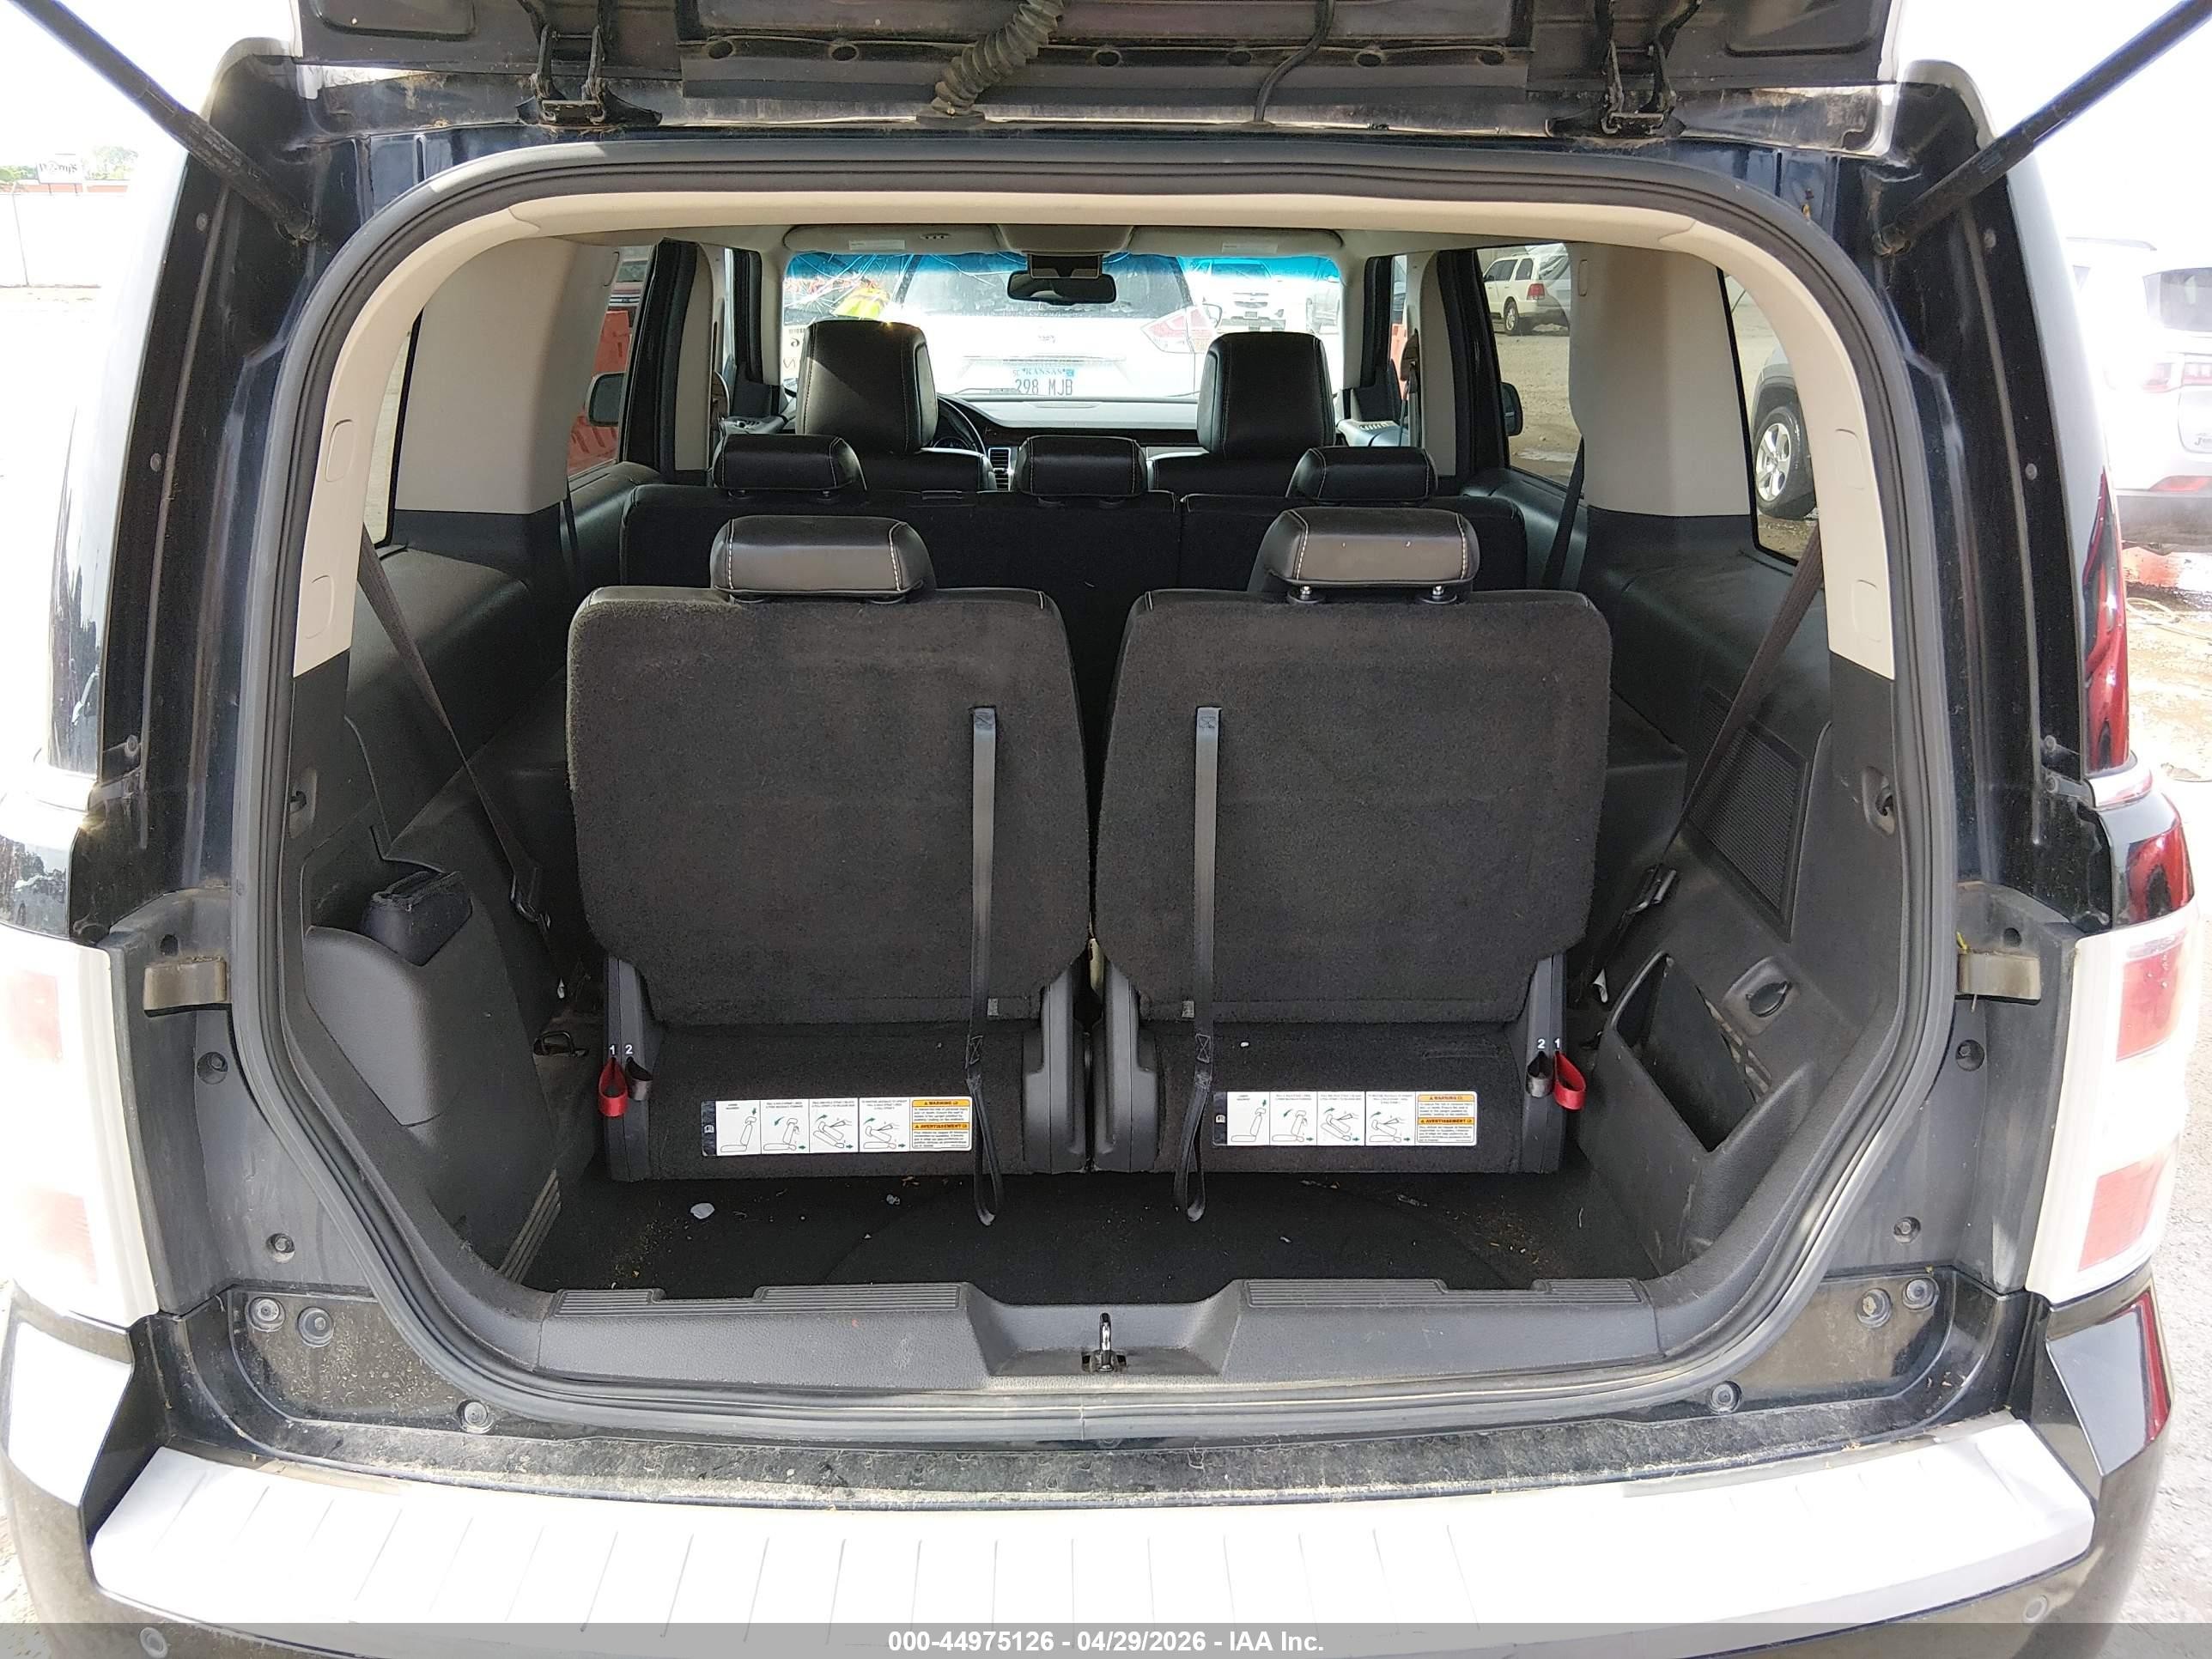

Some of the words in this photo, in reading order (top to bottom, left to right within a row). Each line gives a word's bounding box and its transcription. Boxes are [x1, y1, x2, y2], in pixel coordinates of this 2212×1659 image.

[1015, 379, 1038, 395] 298
[1048, 378, 1073, 396] MJB
[1537, 1038, 1546, 1049] 2
[1554, 1038, 1560, 1048] 1
[609, 1044, 616, 1055] 1
[625, 1044, 634, 1054] 2
